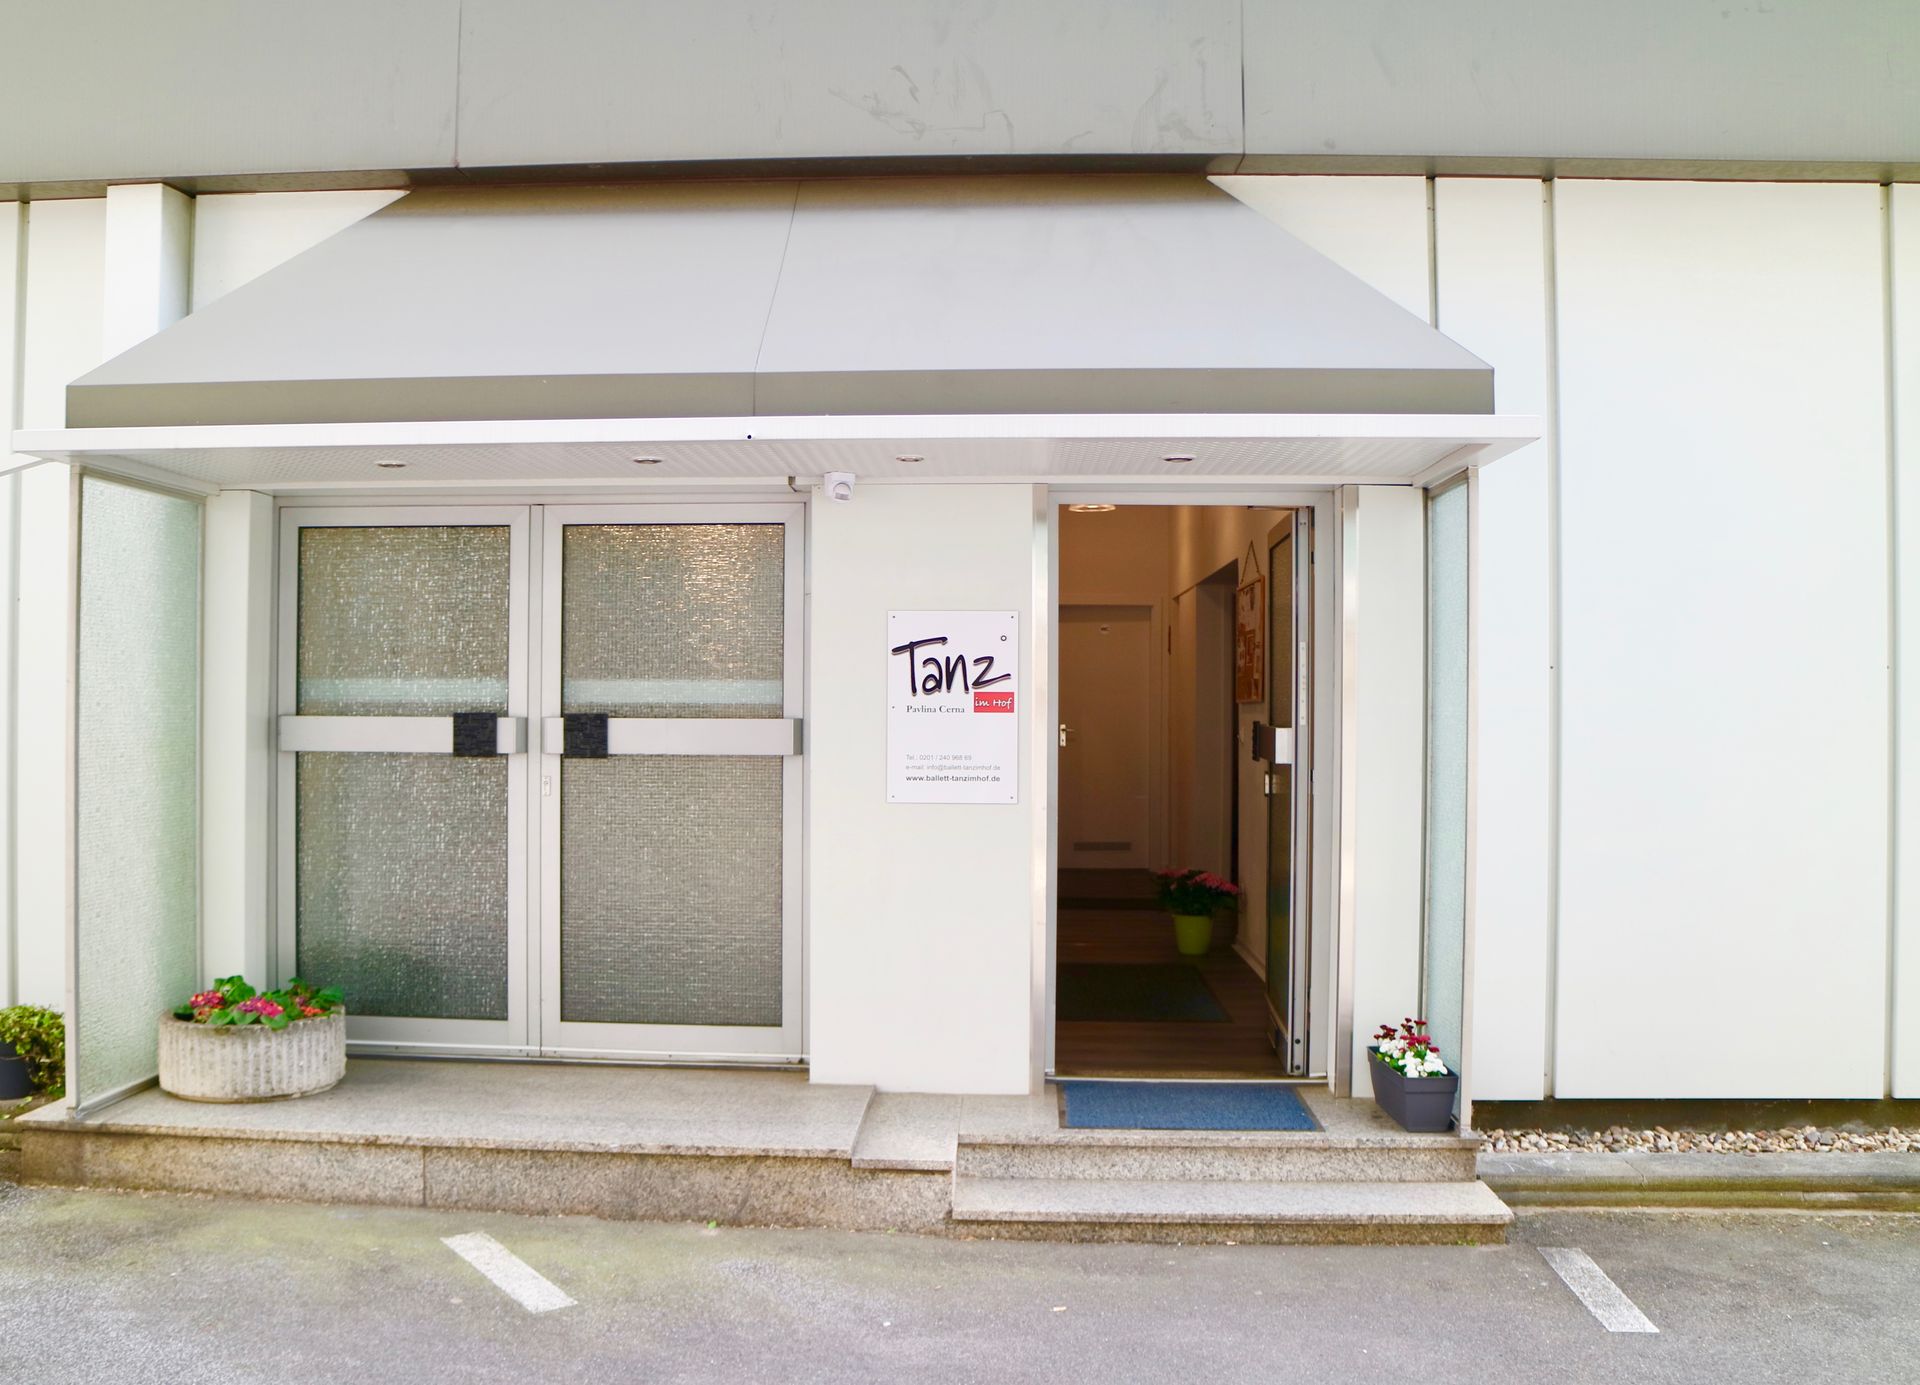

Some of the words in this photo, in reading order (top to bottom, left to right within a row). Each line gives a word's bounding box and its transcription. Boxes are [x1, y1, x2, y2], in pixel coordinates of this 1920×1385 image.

[891, 636, 1012, 696] Tanz
[974, 697, 990, 707] im
[992, 697, 1013, 710] Hof
[906, 705, 937, 713] Pavlina
[938, 705, 965, 713] Cerna
[919, 753, 934, 761] 0201
[905, 774, 1001, 783] www.ballett-tanzimhof.de
